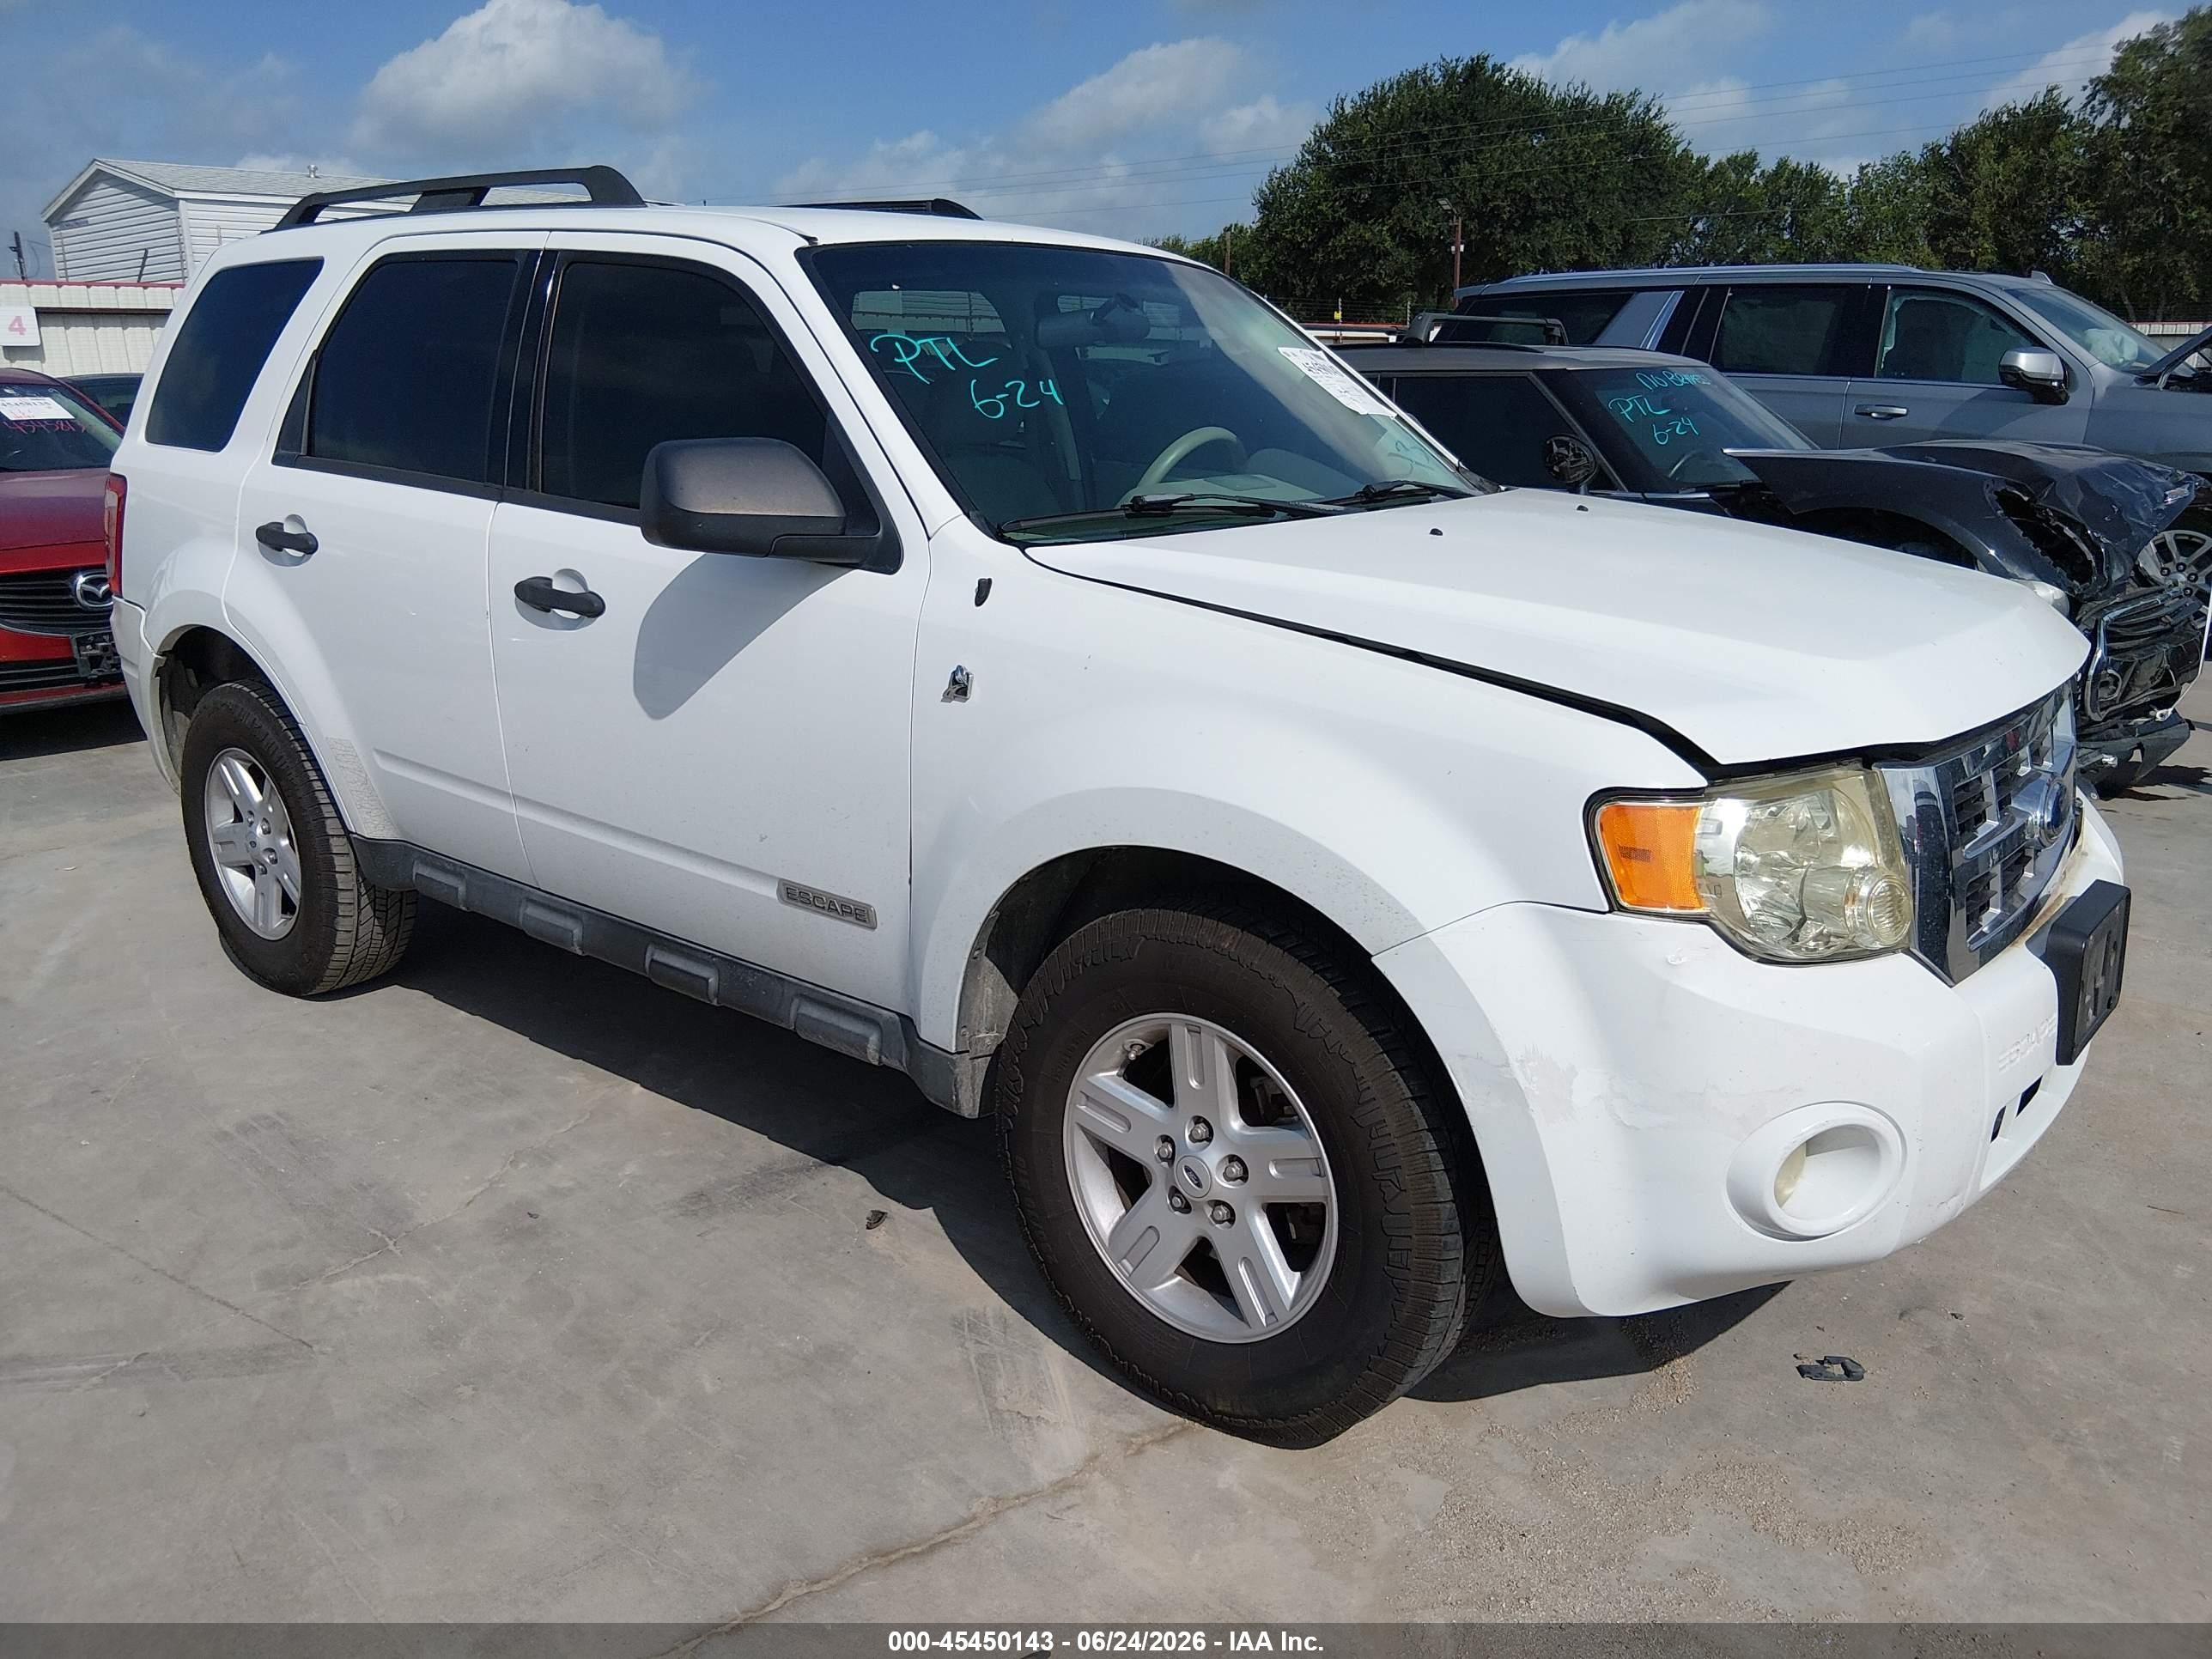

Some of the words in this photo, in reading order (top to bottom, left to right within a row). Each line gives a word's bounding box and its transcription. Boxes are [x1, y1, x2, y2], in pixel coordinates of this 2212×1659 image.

[8, 315, 27, 336] 4
[870, 334, 999, 385] PTL
[970, 379, 1064, 419] 6-24
[1607, 394, 1671, 423] PTL
[1652, 417, 1699, 445] 6-24
[786, 886, 868, 923] ESCAPE
